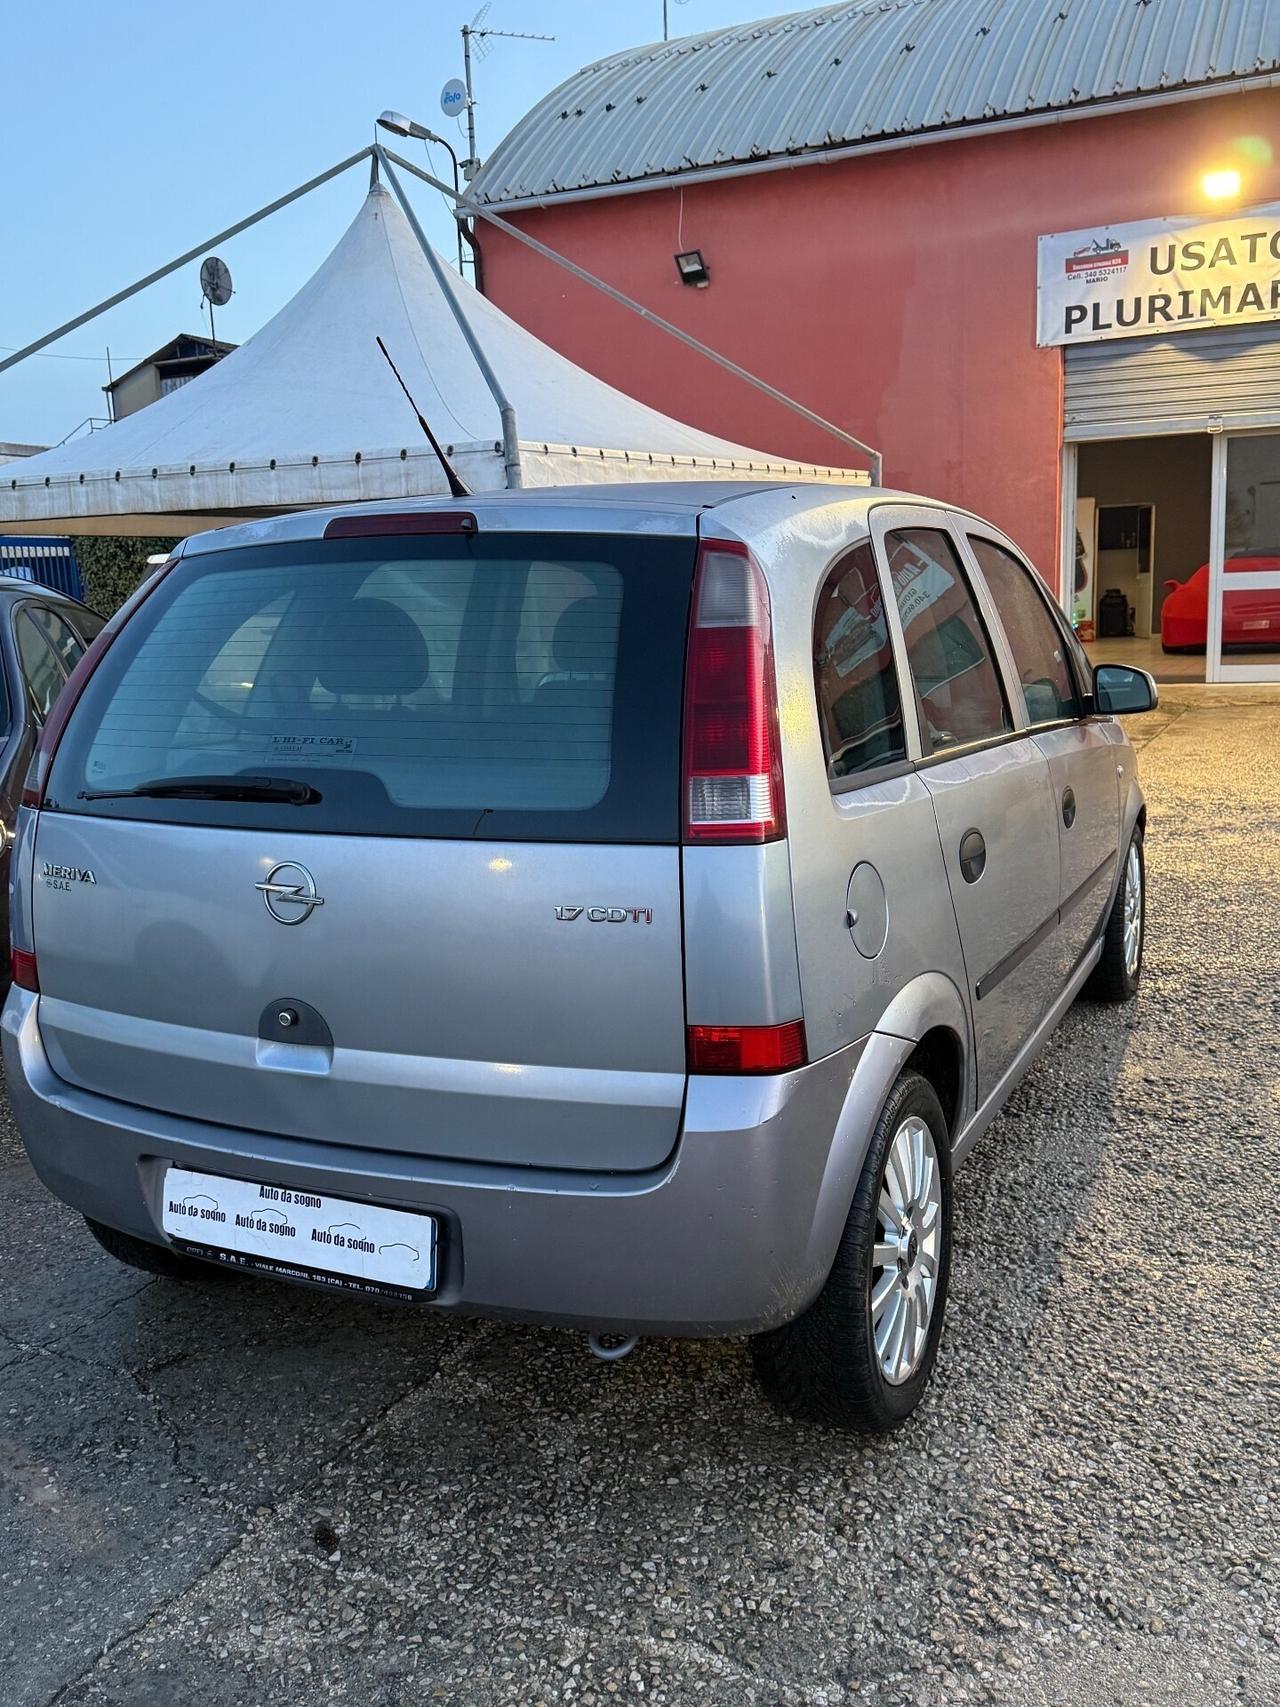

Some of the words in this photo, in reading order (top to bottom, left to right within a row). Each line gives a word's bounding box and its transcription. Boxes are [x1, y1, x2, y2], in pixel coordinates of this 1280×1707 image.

[1085, 271, 1097, 279] 340
[1098, 266, 1127, 276] 5324117
[1086, 276, 1109, 284] MARIO
[43, 862, 97, 885] MERIVA
[587, 906, 652, 923] CDTI
[260, 1186, 279, 1201] Auto
[281, 1190, 292, 1203] da
[294, 1194, 322, 1208] sogno
[169, 1201, 187, 1215] Auto
[188, 1205, 198, 1217] da
[200, 1209, 226, 1222] sogno
[235, 1214, 254, 1229] Auto
[256, 1219, 267, 1231] da
[269, 1223, 296, 1237] sogno
[311, 1229, 332, 1244] Auto
[334, 1233, 345, 1247] da
[347, 1238, 375, 1253] sogno
[219, 1253, 249, 1266] S.A.E.
[255, 1262, 274, 1271] VIALE
